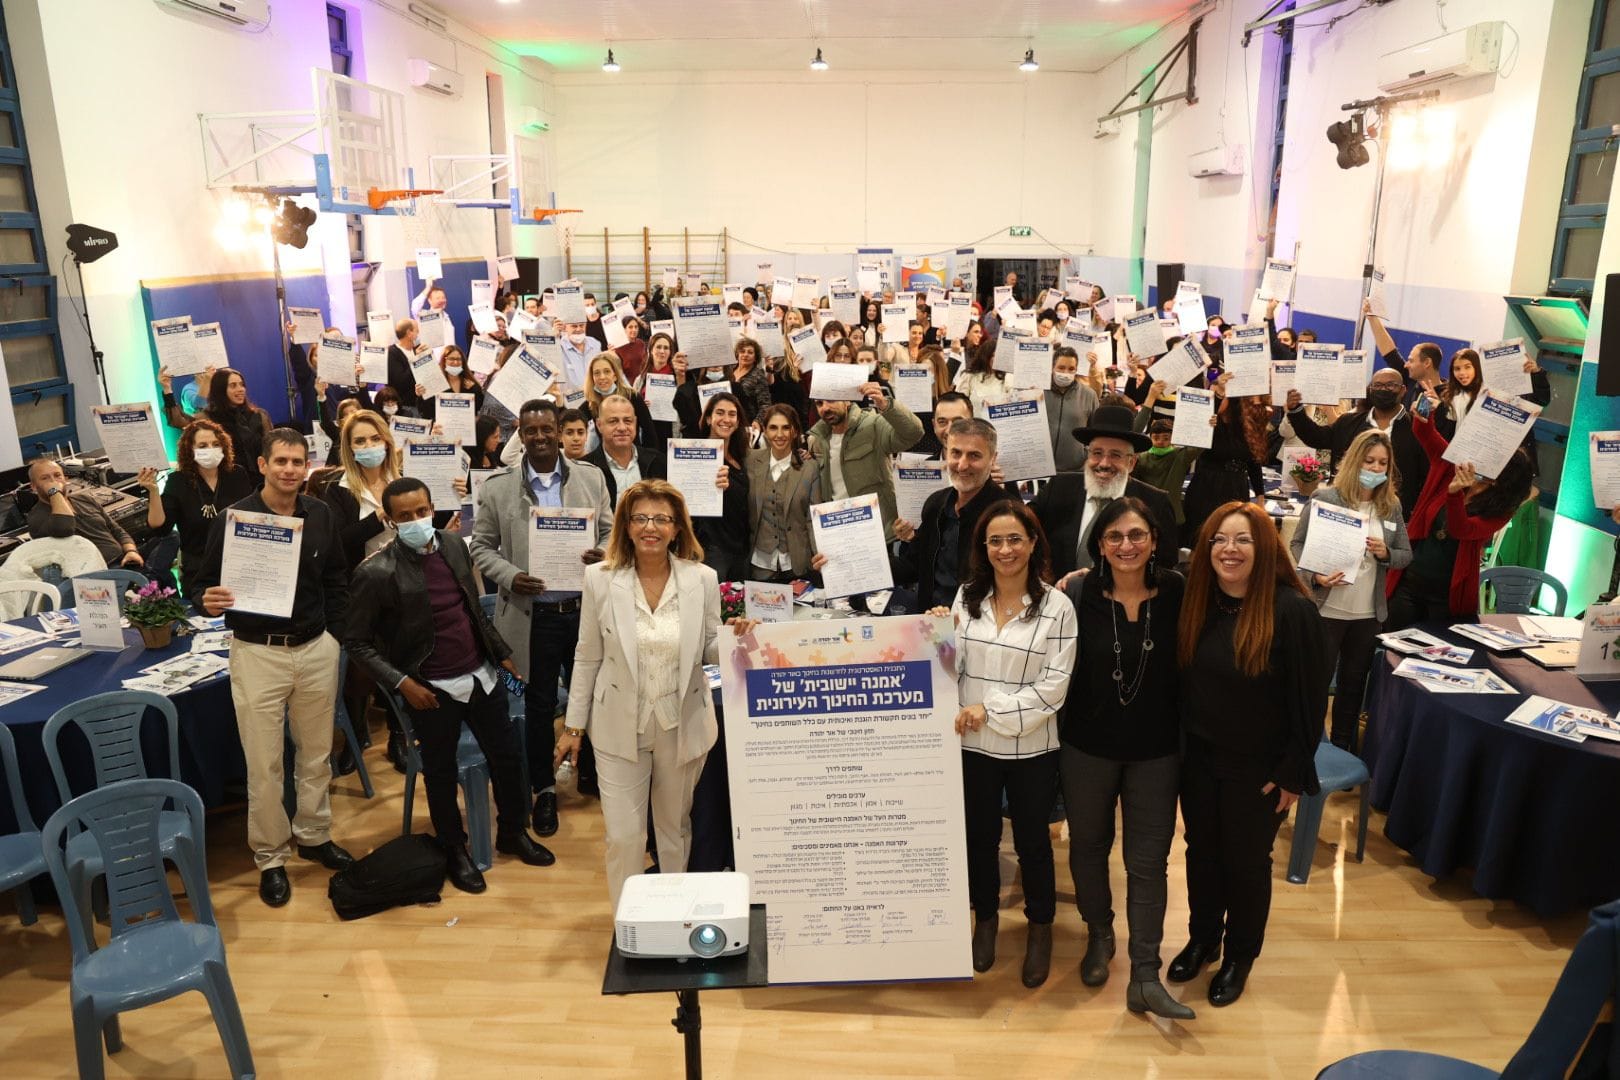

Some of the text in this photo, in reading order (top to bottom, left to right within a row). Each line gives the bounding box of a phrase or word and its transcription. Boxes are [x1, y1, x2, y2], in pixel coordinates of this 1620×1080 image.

[772, 679, 796, 693] של
[756, 690, 924, 711] מערכת החינוך העירונית
